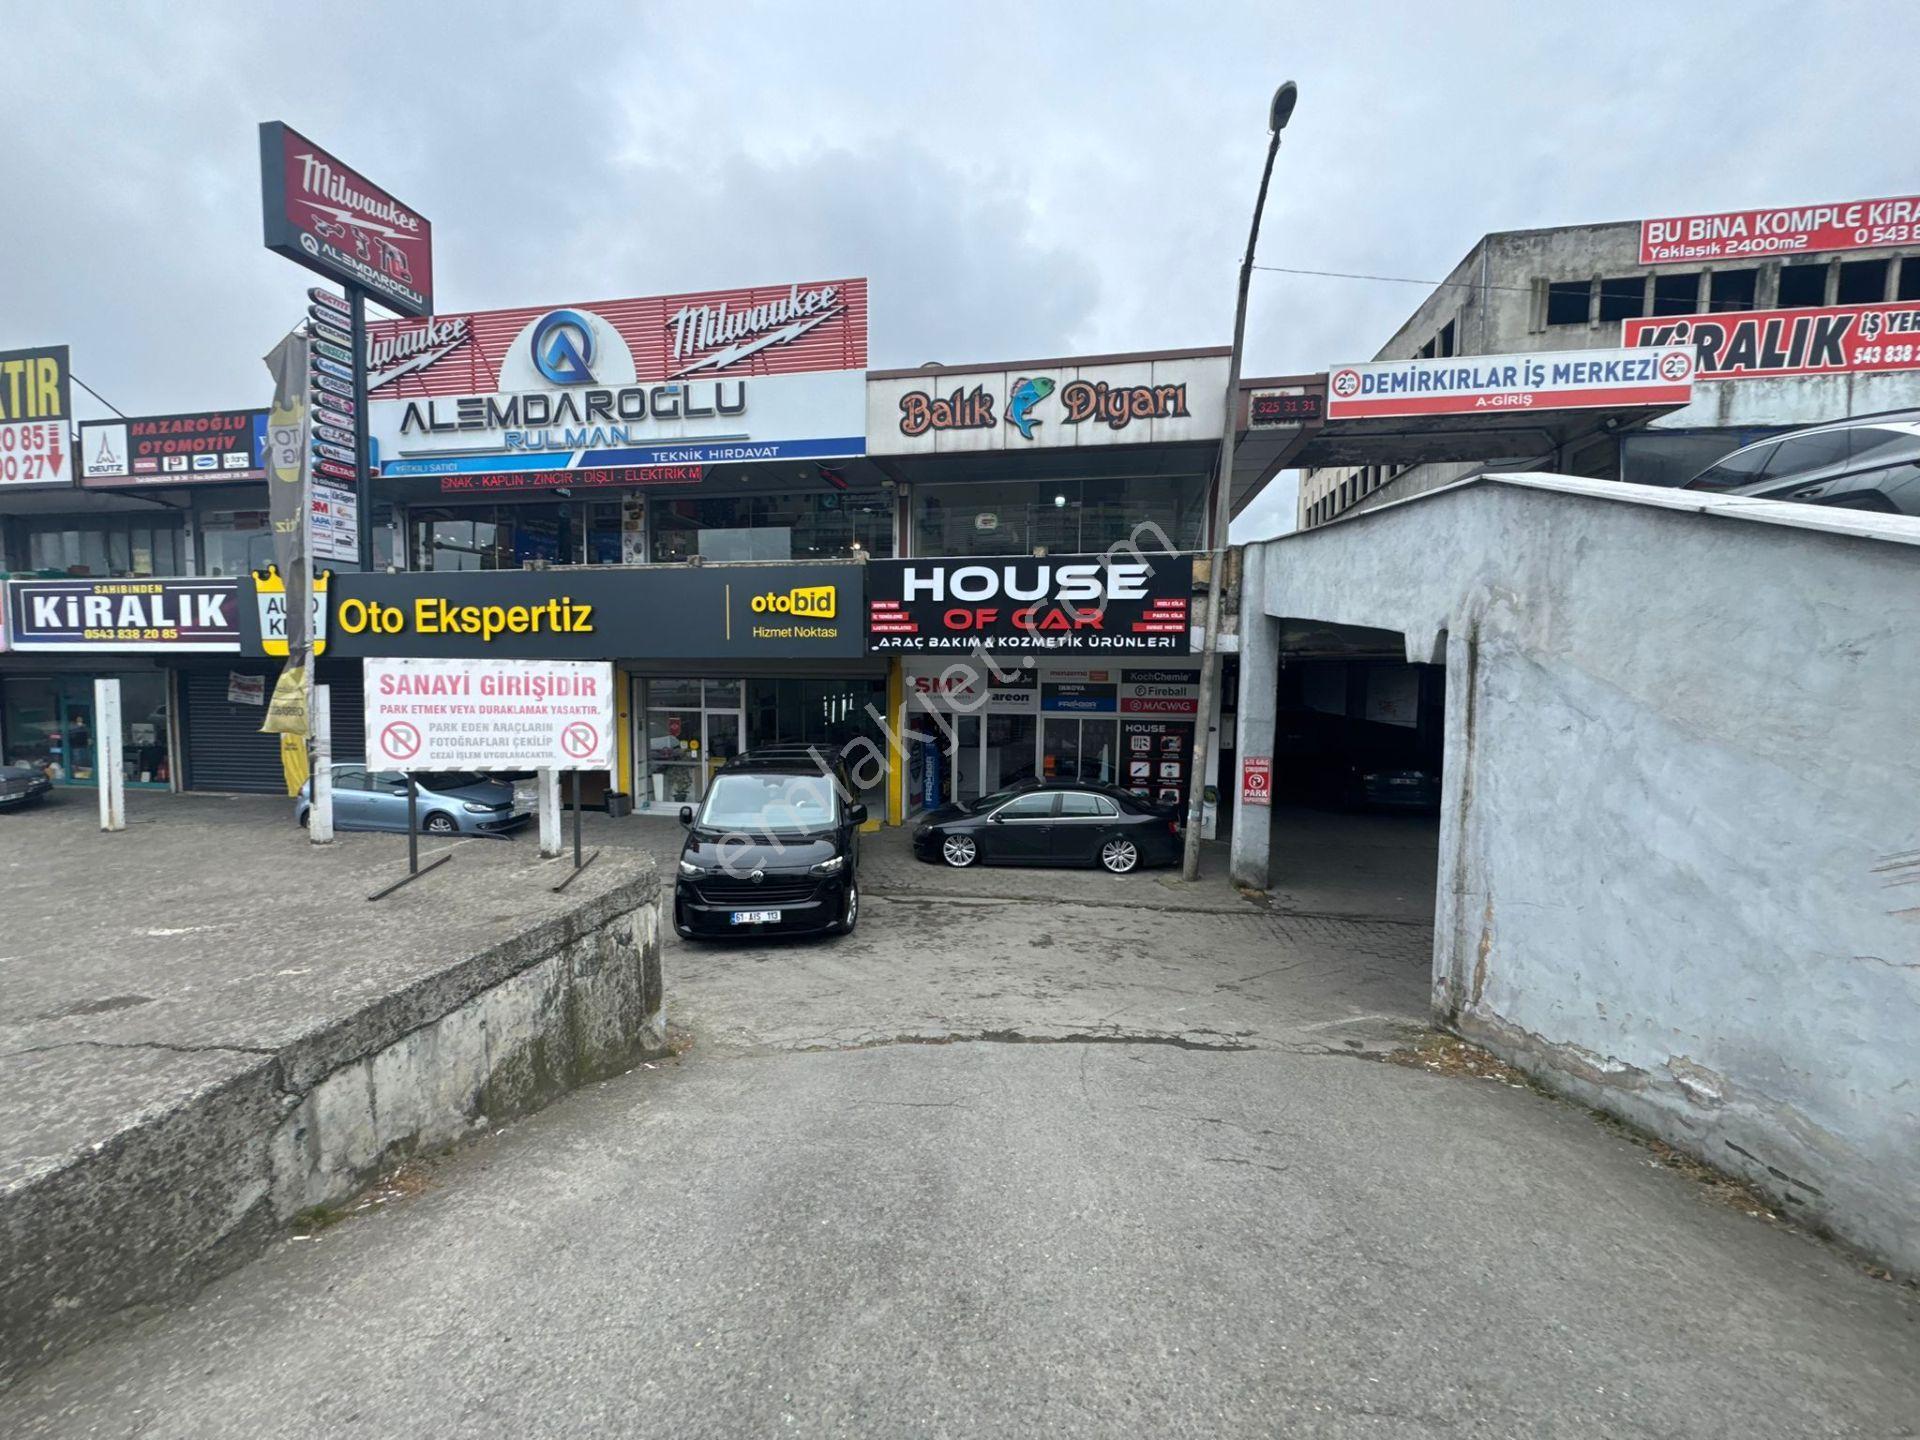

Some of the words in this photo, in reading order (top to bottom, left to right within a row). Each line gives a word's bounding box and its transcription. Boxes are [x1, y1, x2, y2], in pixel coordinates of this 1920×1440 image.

[294, 154, 420, 232] Milwaukee
[1648, 222, 1682, 243] BU
[1755, 205, 1861, 236] KOMPLE
[1725, 235, 1808, 254] 2400m2
[1872, 226, 1908, 242] 543
[667, 285, 838, 358] Milwaukee
[366, 315, 472, 370] lwaukee
[1853, 346, 1881, 364] 543
[1884, 345, 1912, 362] 838
[1361, 363, 1515, 395] DEMİRKIRLAR
[1523, 357, 1545, 387] İŞ
[1553, 352, 1660, 385] MERKEZİ
[1475, 393, 1534, 408] A-GİRİŞ
[132, 413, 246, 437] HAZAROĞLU
[21, 424, 44, 450] 85
[138, 435, 237, 455] OTOMOTİV
[505, 424, 630, 452] RULMAN
[651, 447, 703, 463] TEKNİK
[708, 445, 779, 460] HIRDAVAT
[23, 454, 44, 480] 27
[88, 464, 123, 473] DEUTZ
[904, 564, 1150, 601] HOUSE
[751, 590, 833, 614] otobid
[338, 599, 404, 634] Oto
[415, 596, 594, 642] Ekspertiz
[943, 608, 999, 630] OF
[1011, 607, 1105, 630] CAR
[84, 629, 115, 640] 0543
[117, 629, 140, 640] 838
[143, 629, 159, 640] 20
[162, 629, 178, 640] 85
[753, 626, 792, 638] Hizmet
[878, 637, 924, 650] ARAÇ
[929, 637, 979, 648] BAKIM
[998, 634, 1083, 648] KOZMETİK
[1088, 634, 1177, 648] ÜRÜNLERİ
[380, 670, 470, 696] SANAYİ
[480, 670, 597, 701] GİRİŞİDİR
[1148, 687, 1187, 696] Fireball
[992, 693, 1030, 702] areon
[380, 705, 408, 715] PARK
[411, 705, 447, 715] ETMEK
[450, 705, 476, 715] VEYA
[479, 706, 548, 715] DURAKLAMAK
[429, 723, 458, 733] PARK
[461, 723, 490, 732] EDEN
[429, 735, 510, 747] FOTOĞRAFLARI
